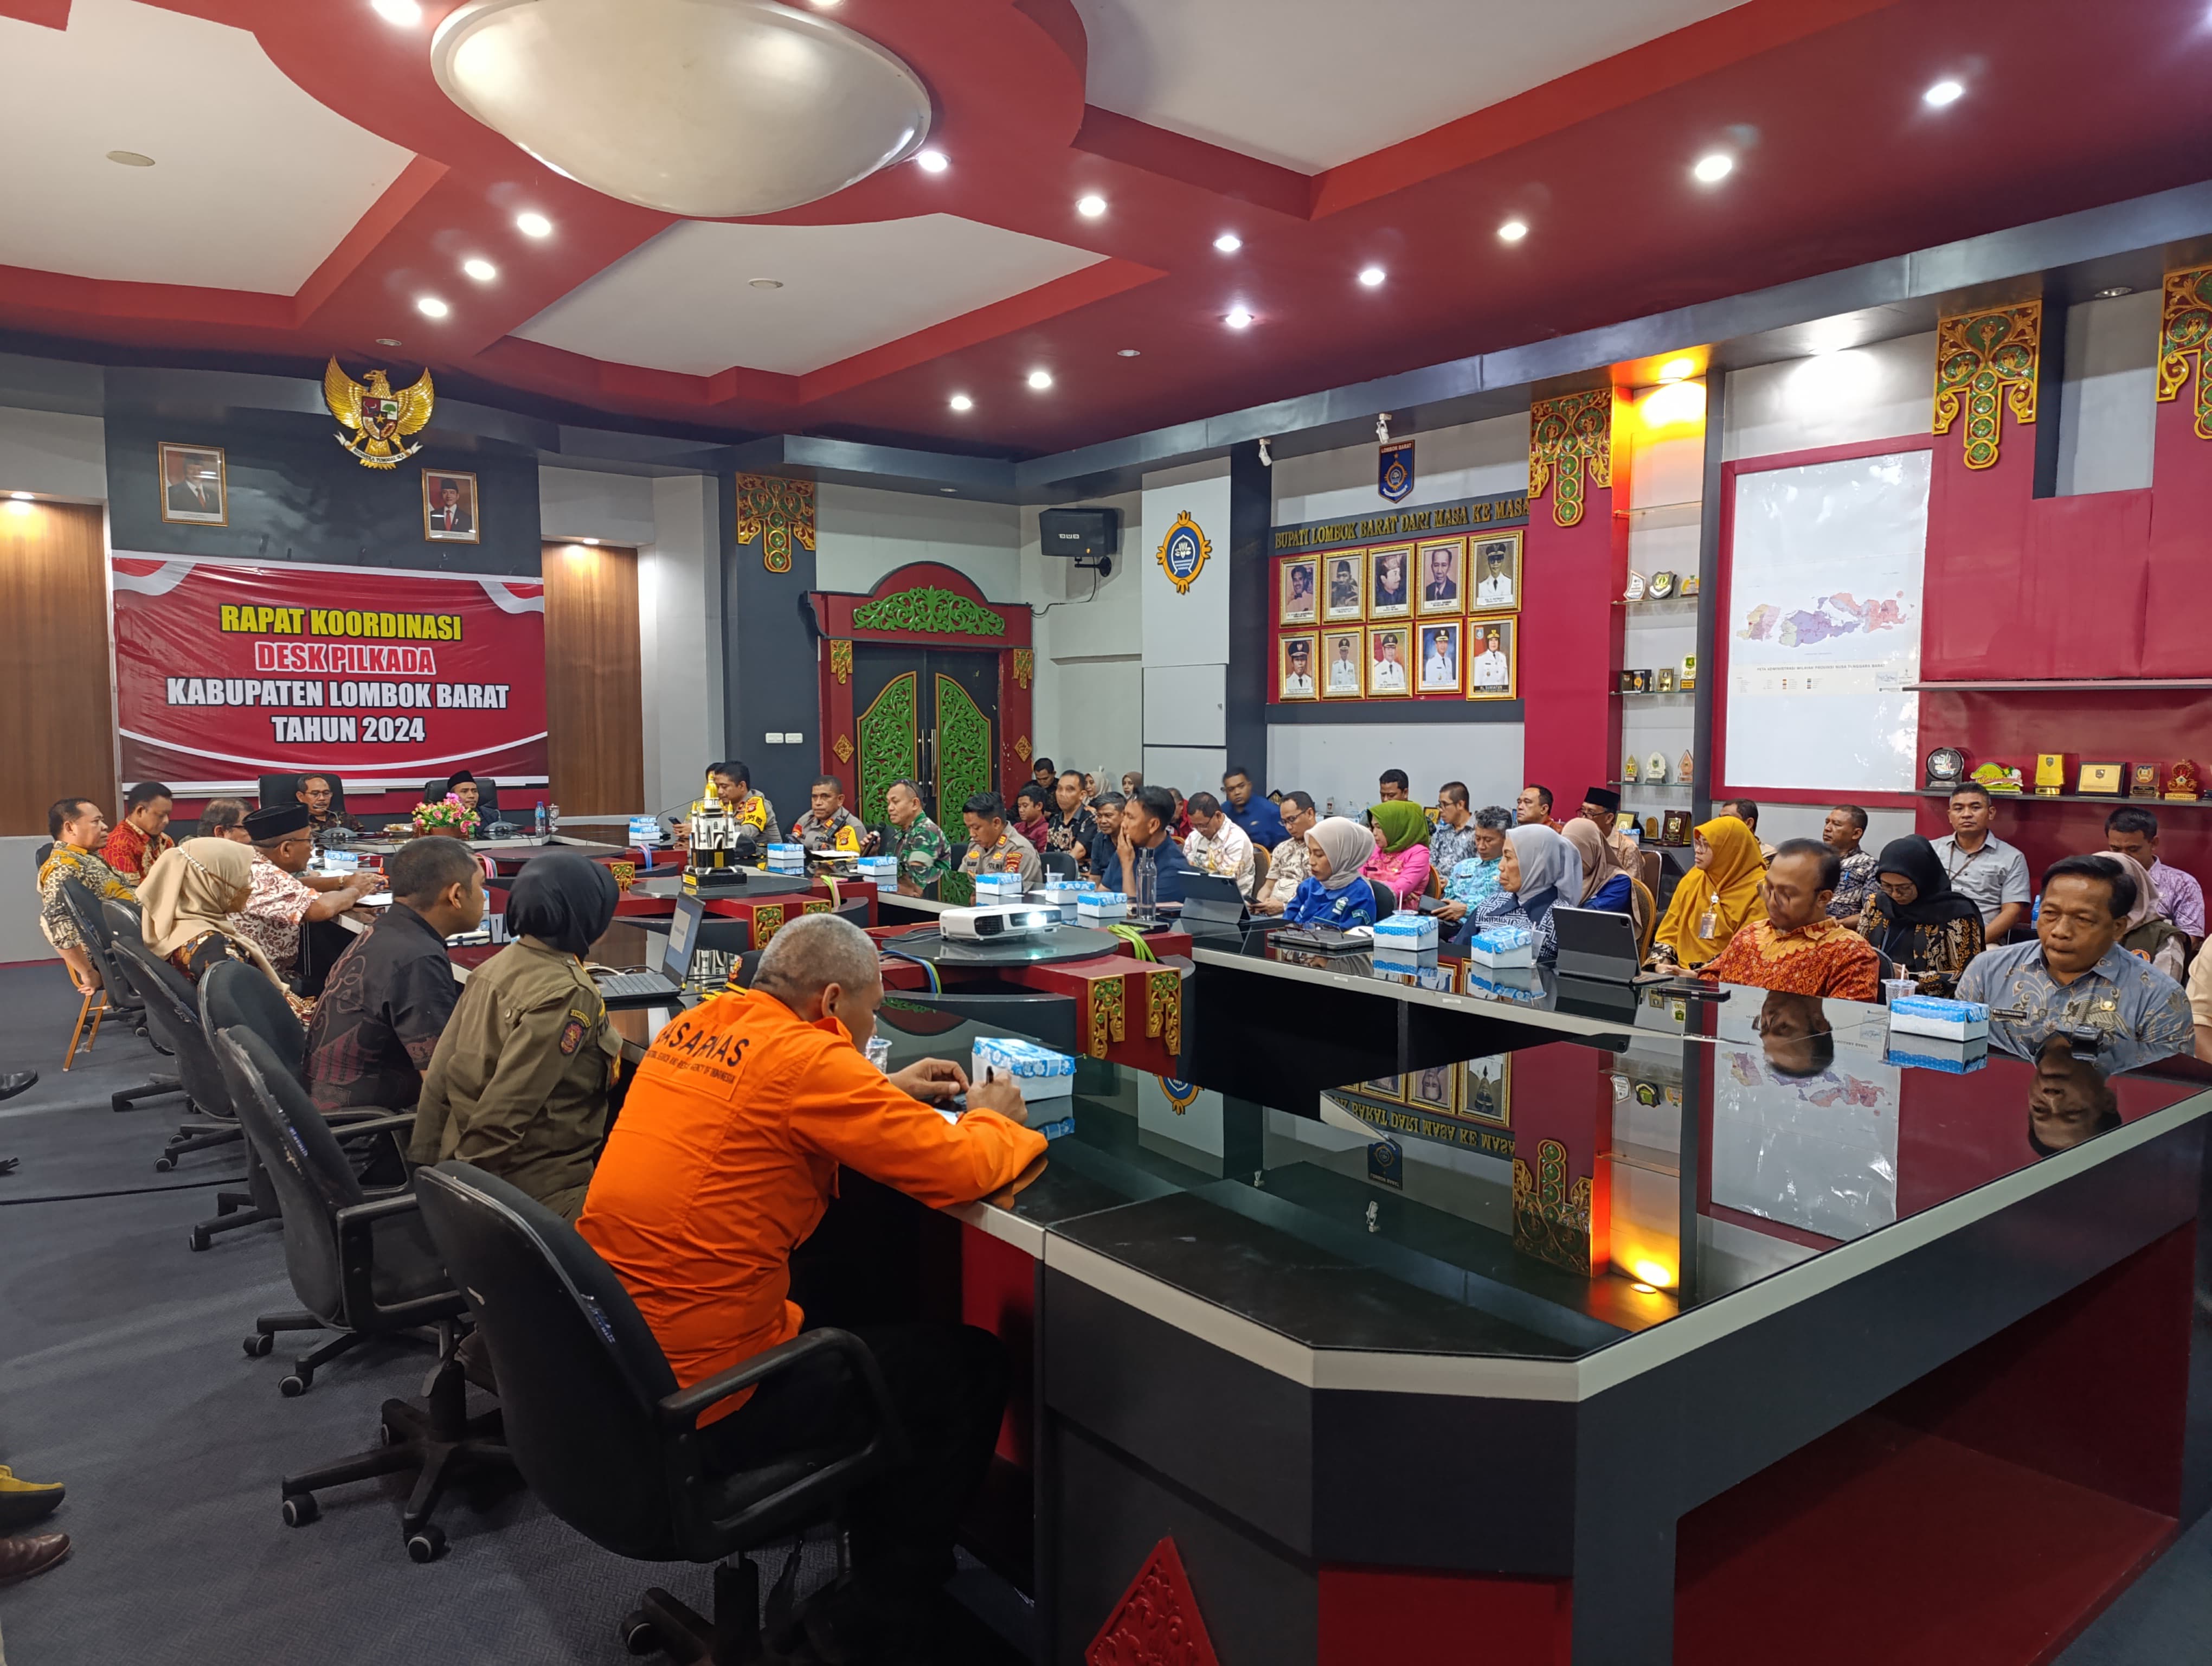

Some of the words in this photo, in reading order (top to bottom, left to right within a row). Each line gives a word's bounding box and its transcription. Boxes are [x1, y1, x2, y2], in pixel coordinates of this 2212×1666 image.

[1381, 445, 1398, 453] LOMBOK
[1275, 528, 1309, 549] BUPATI
[1311, 522, 1356, 542] LOMBOK
[1360, 517, 1398, 537] BARAT
[1401, 511, 1431, 531] DARI
[1434, 507, 1468, 528] MASA
[1472, 503, 1491, 523] KE
[1495, 497, 1529, 519] MASA
[221, 604, 305, 635] RAPAT
[311, 610, 462, 640] KOORDINASI
[255, 642, 327, 672] DESK
[328, 644, 436, 675] PILKADA
[166, 678, 324, 706] KABUPATEN
[329, 681, 432, 707] LOMBOK
[436, 684, 510, 708] BARAT
[272, 716, 357, 742] TAHUN
[362, 716, 425, 742] 2024
[655, 1021, 750, 1067] ASARNAS
